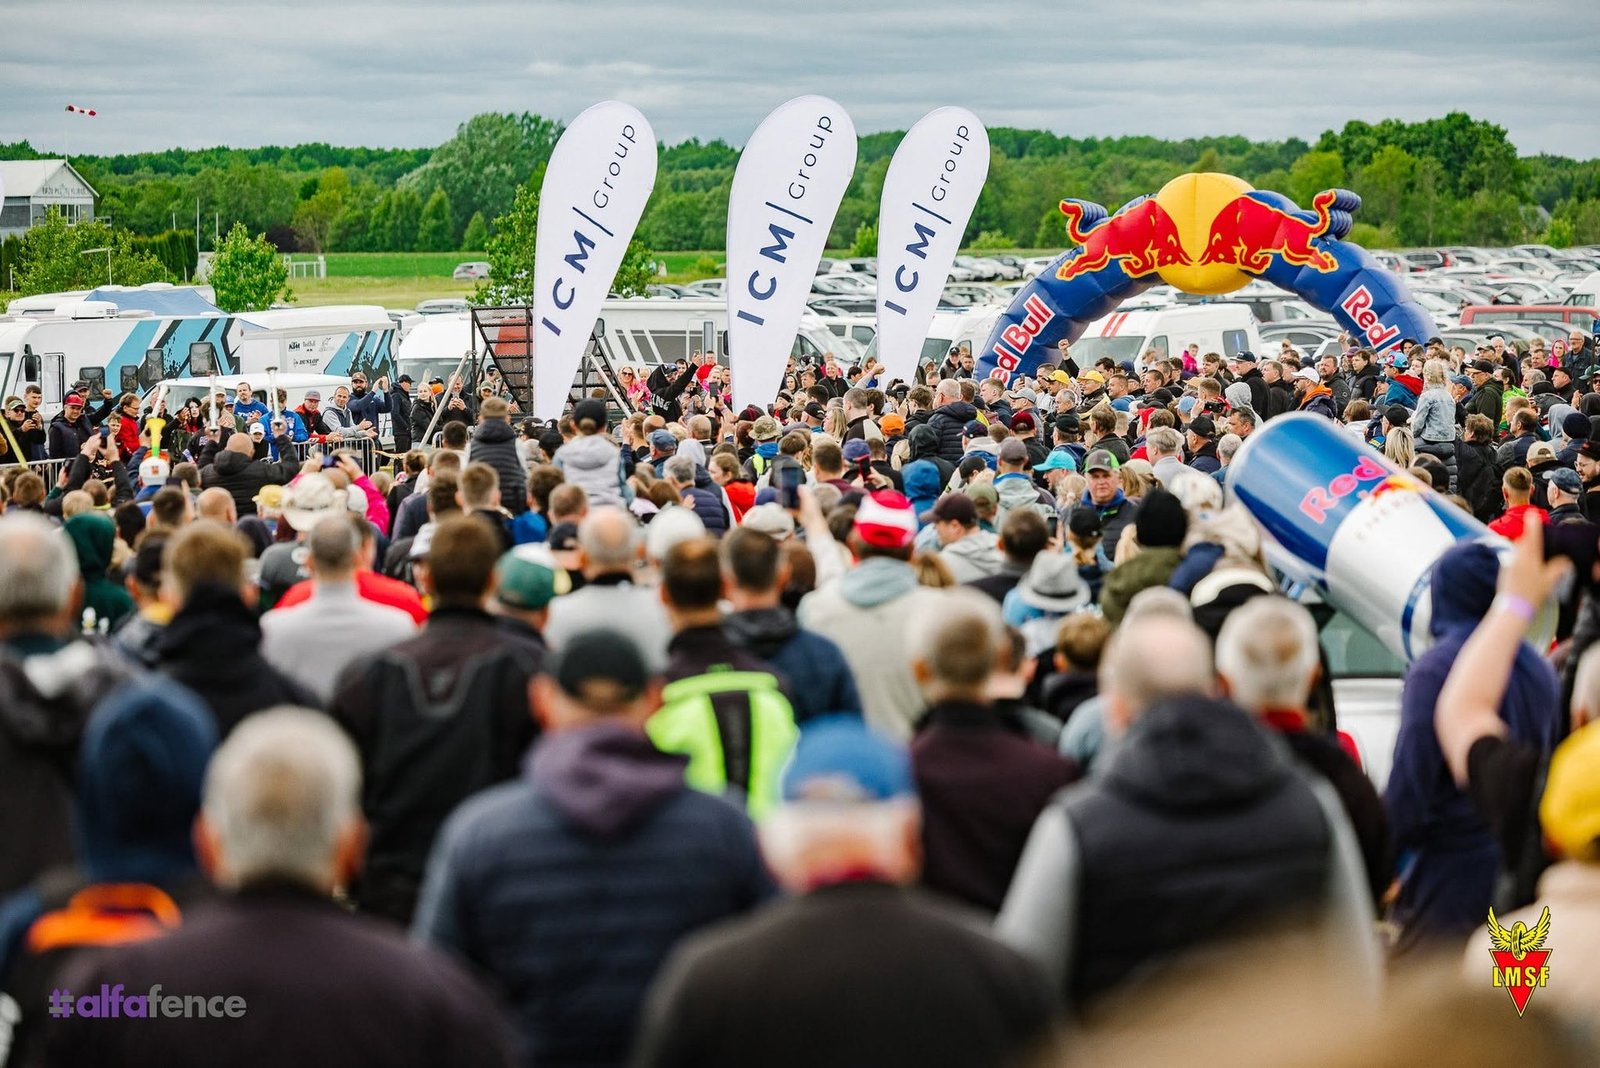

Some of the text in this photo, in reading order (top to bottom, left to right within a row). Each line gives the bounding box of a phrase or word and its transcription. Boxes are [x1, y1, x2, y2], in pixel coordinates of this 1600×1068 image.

[541, 124, 637, 337] ICM Group
[736, 115, 833, 326] ICM Group
[884, 125, 970, 316] ICM Group
[989, 292, 1056, 389] ed Bull
[1340, 284, 1401, 349] Red
[1298, 455, 1389, 525] Red
